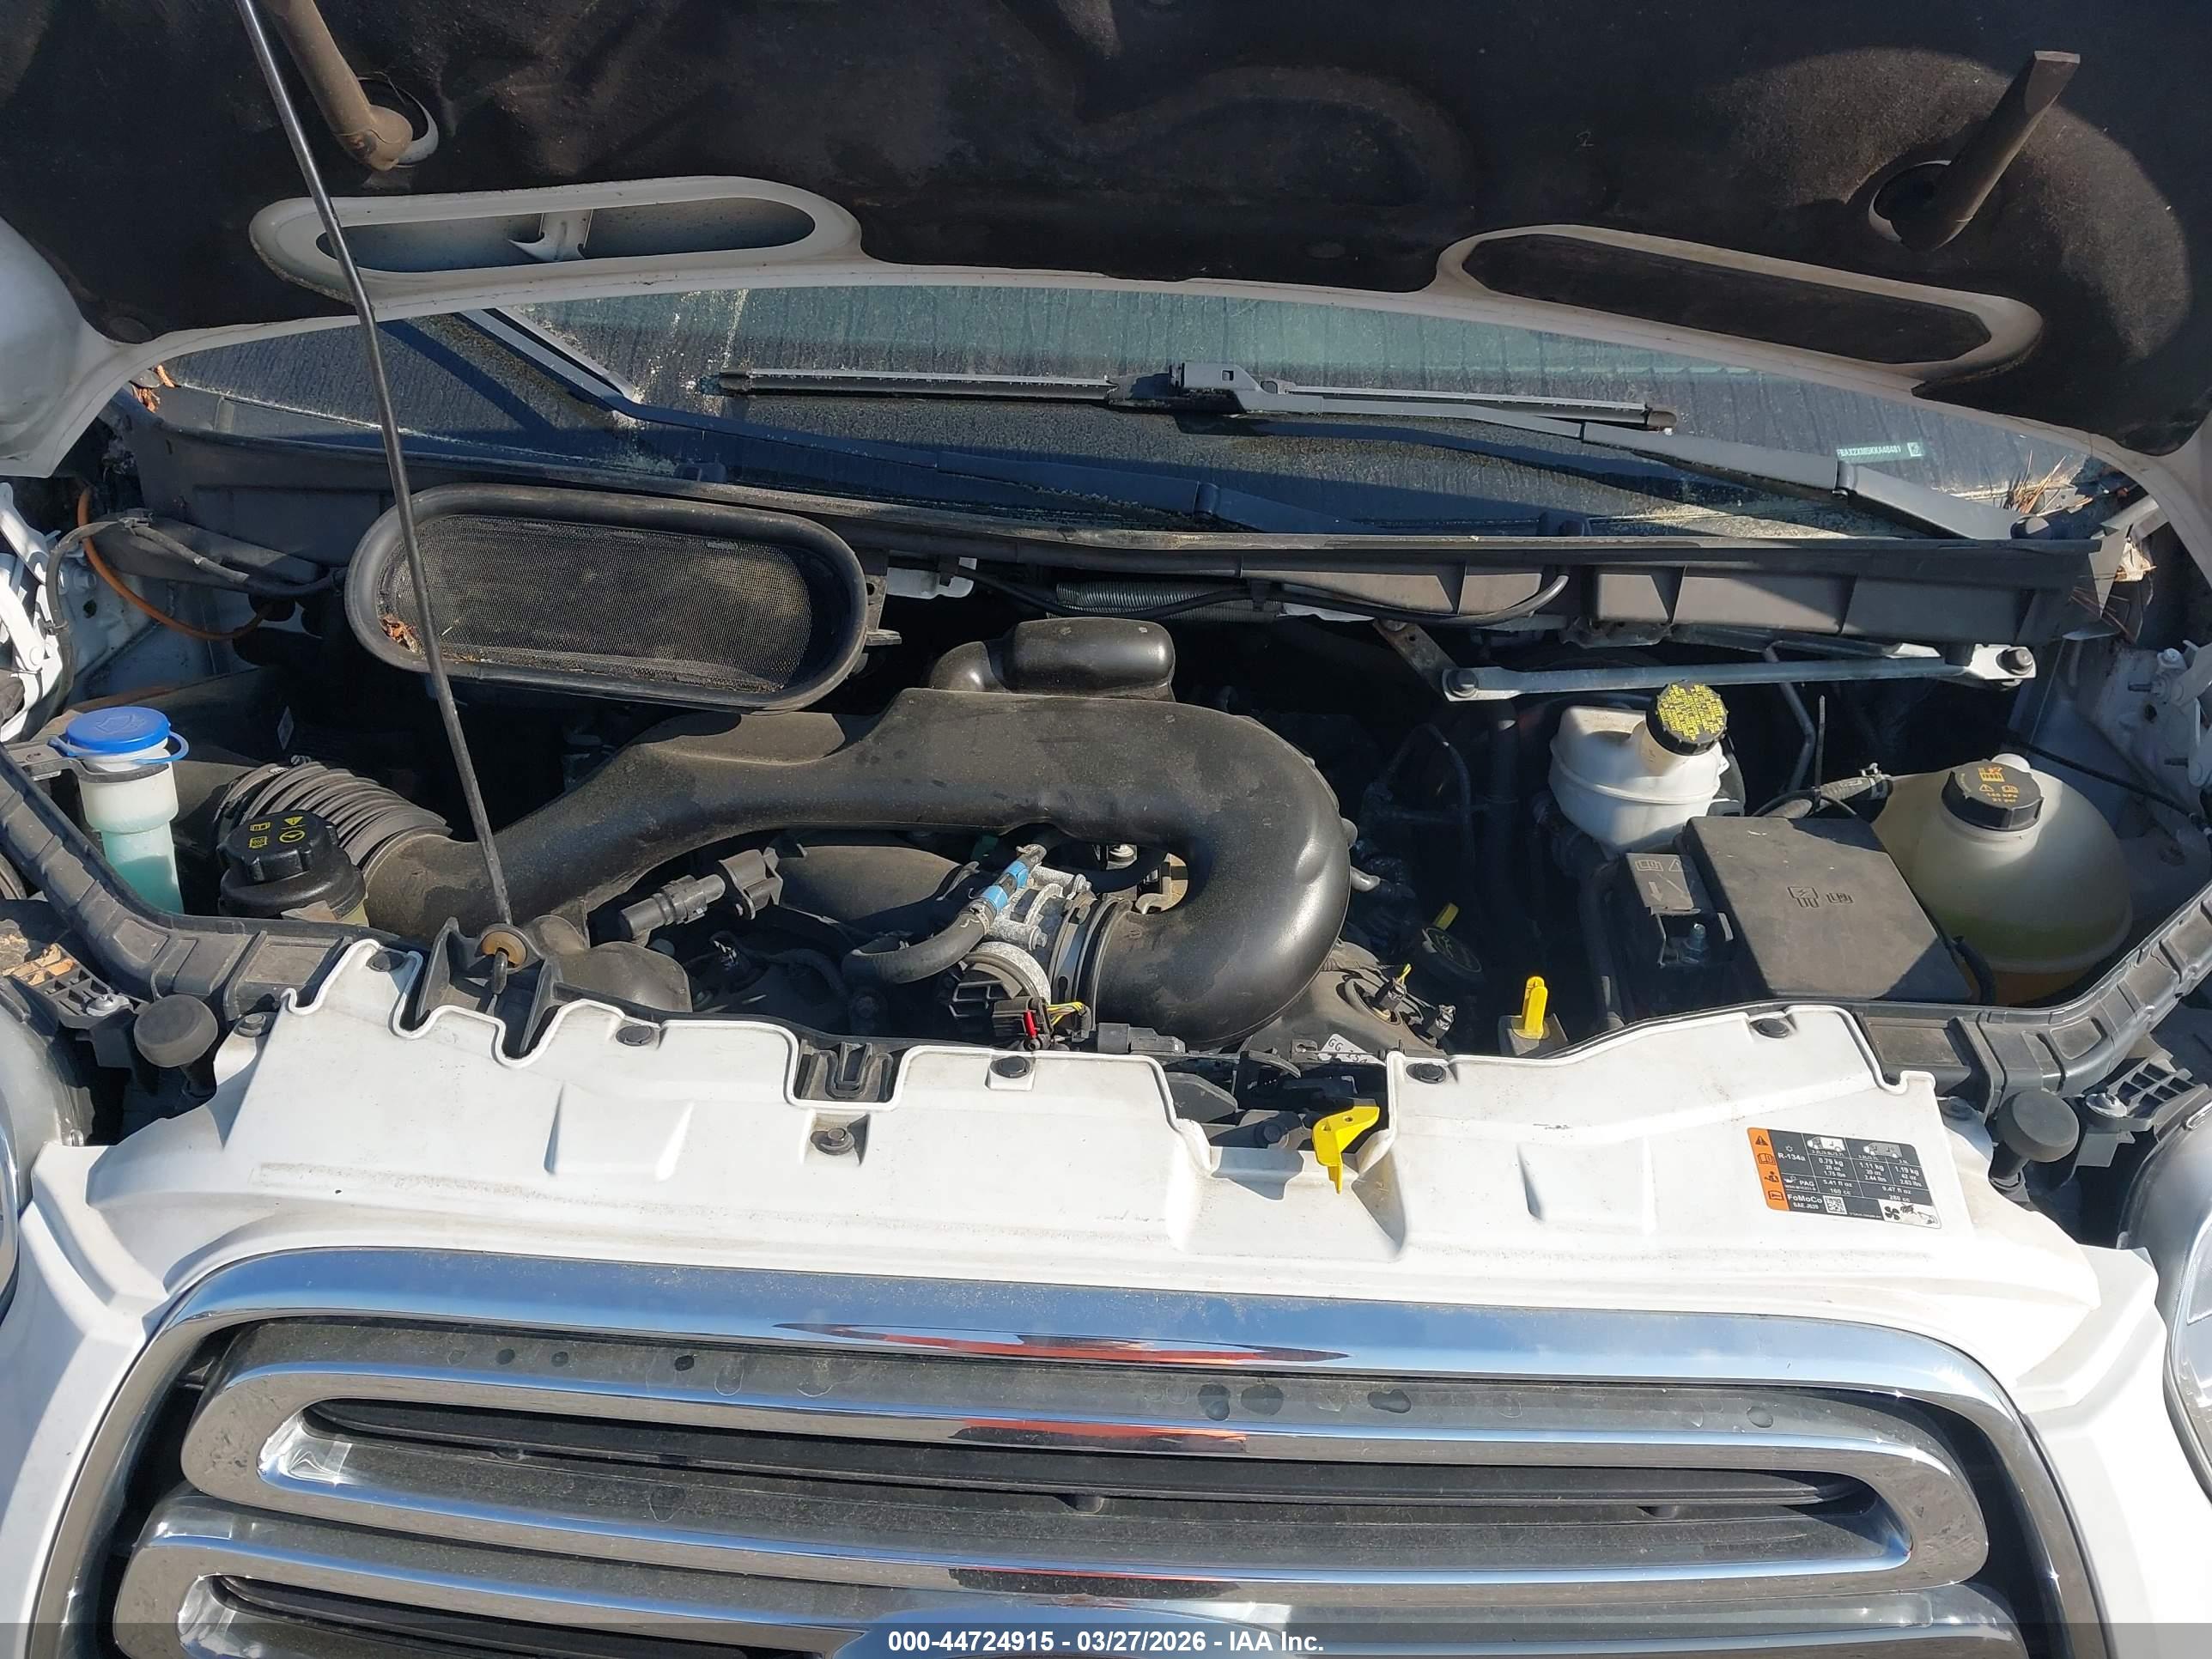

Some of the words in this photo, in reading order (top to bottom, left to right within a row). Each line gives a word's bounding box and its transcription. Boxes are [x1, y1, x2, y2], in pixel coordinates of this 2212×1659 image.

[1328, 1039, 1344, 1051] GG
[1778, 1152, 1806, 1162] R-134a
[1875, 1163, 1885, 1171] kg
[1787, 1194, 1822, 1203] FoMoCo
